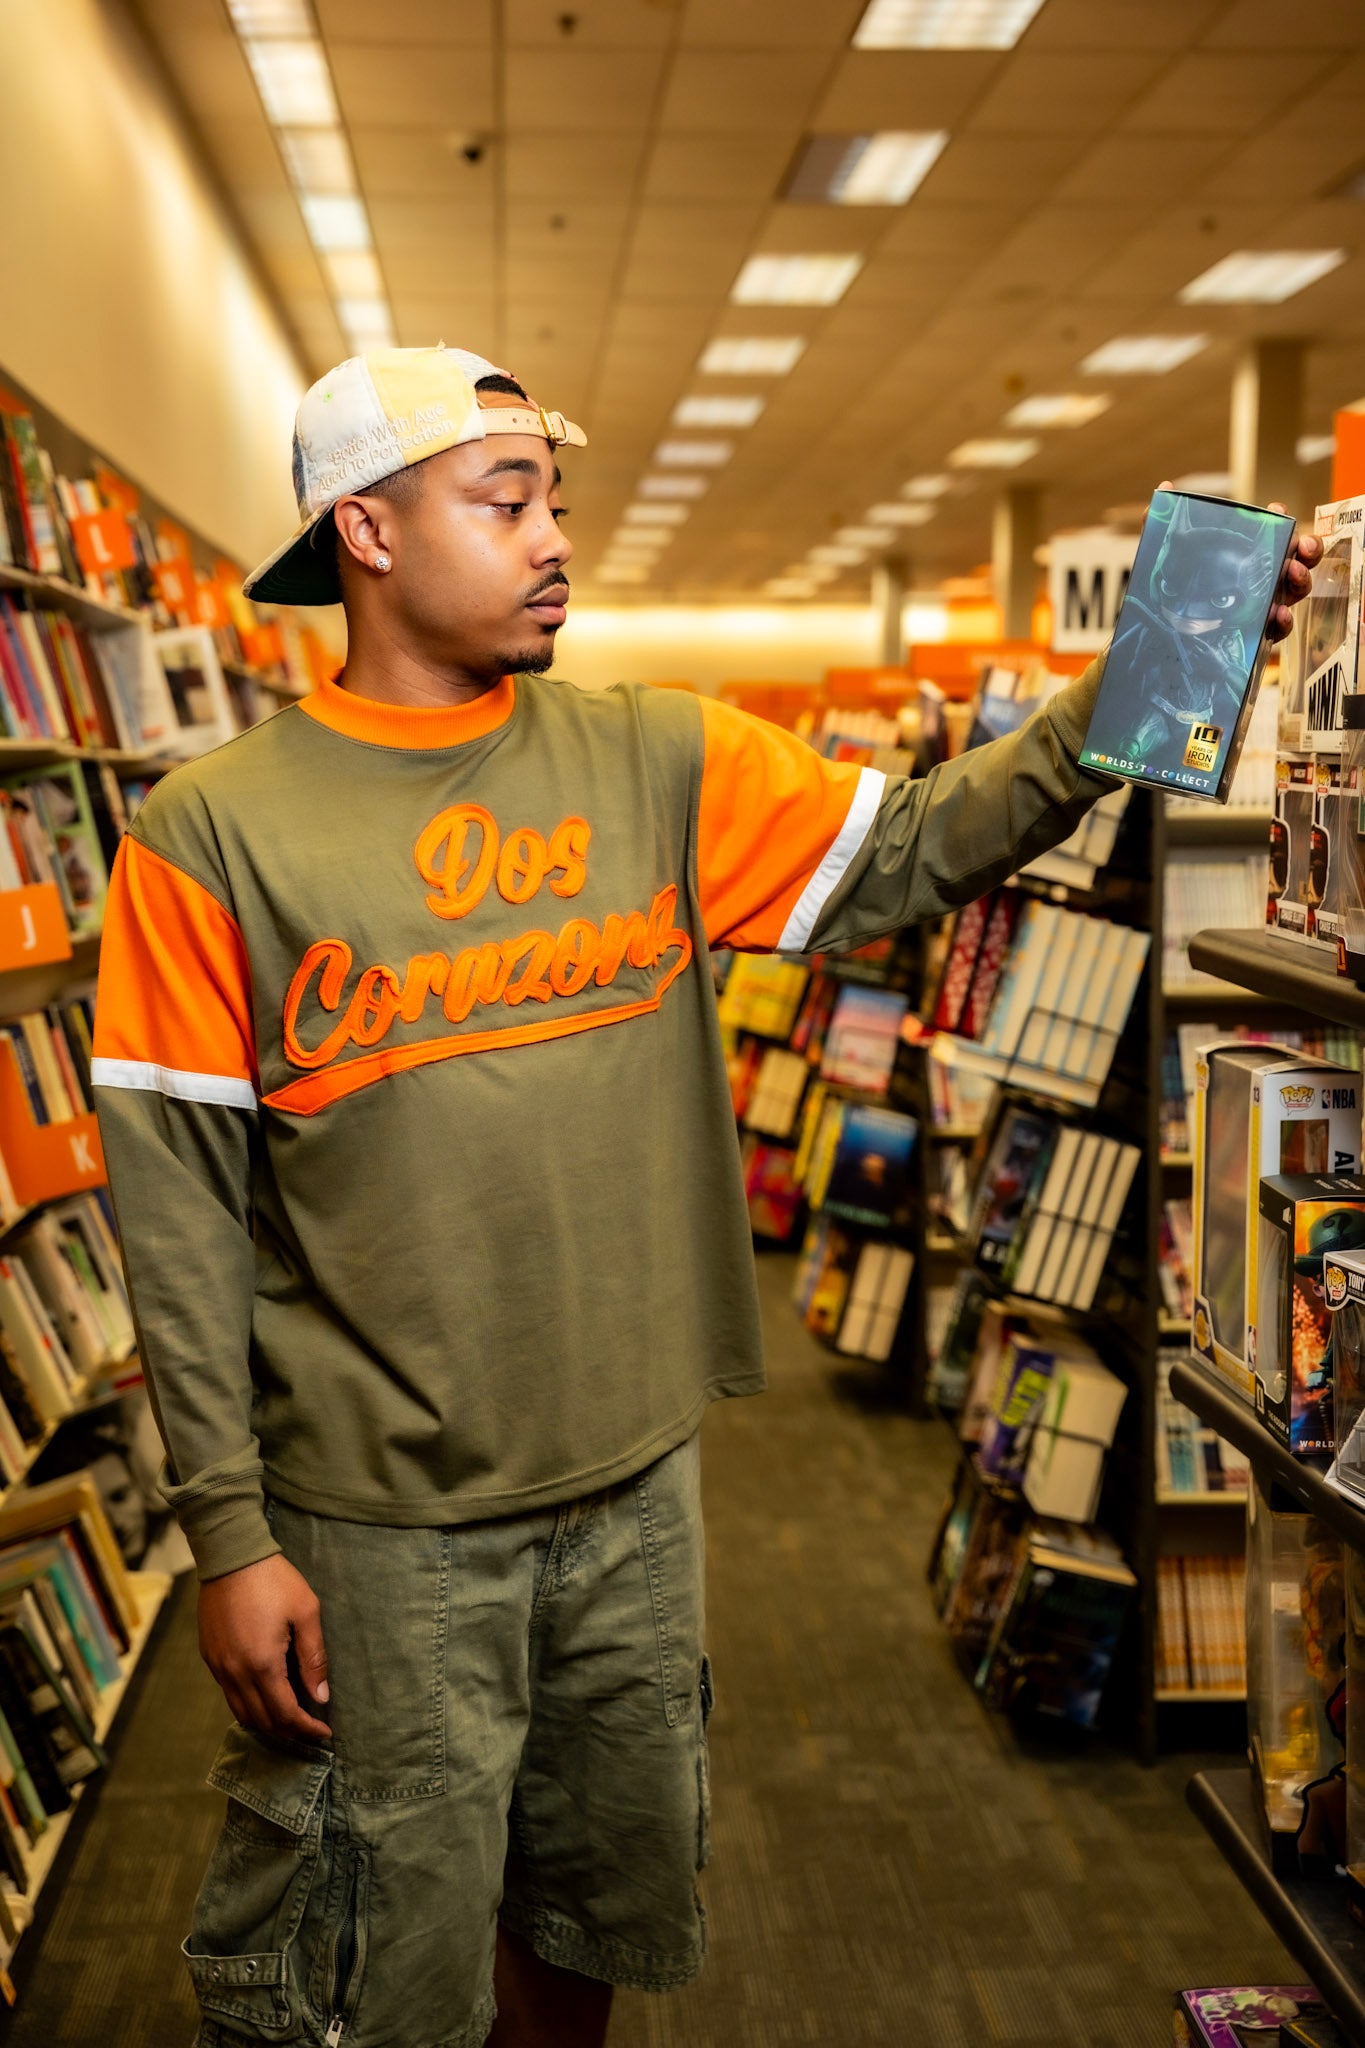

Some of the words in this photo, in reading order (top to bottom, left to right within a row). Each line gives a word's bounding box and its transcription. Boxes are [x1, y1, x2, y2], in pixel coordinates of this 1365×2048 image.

[369, 415, 411, 443] With
[414, 403, 446, 428] Age
[318, 462, 348, 495] Aged
[369, 418, 454, 465] Perfection
[1338, 508, 1363, 525] PSYLOCKE
[1090, 752, 1134, 770] WORLDS
[1161, 770, 1210, 788] COLLECT
[1186, 758, 1210, 769] STUDIOS
[1188, 750, 1213, 763] IRON
[414, 803, 591, 920] Dos
[21, 905, 37, 951] J
[1280, 1086, 1315, 1104] POP!
[1333, 1088, 1356, 1109] NBA
[70, 1132, 97, 1173] K
[1348, 1272, 1365, 1292] TONY
